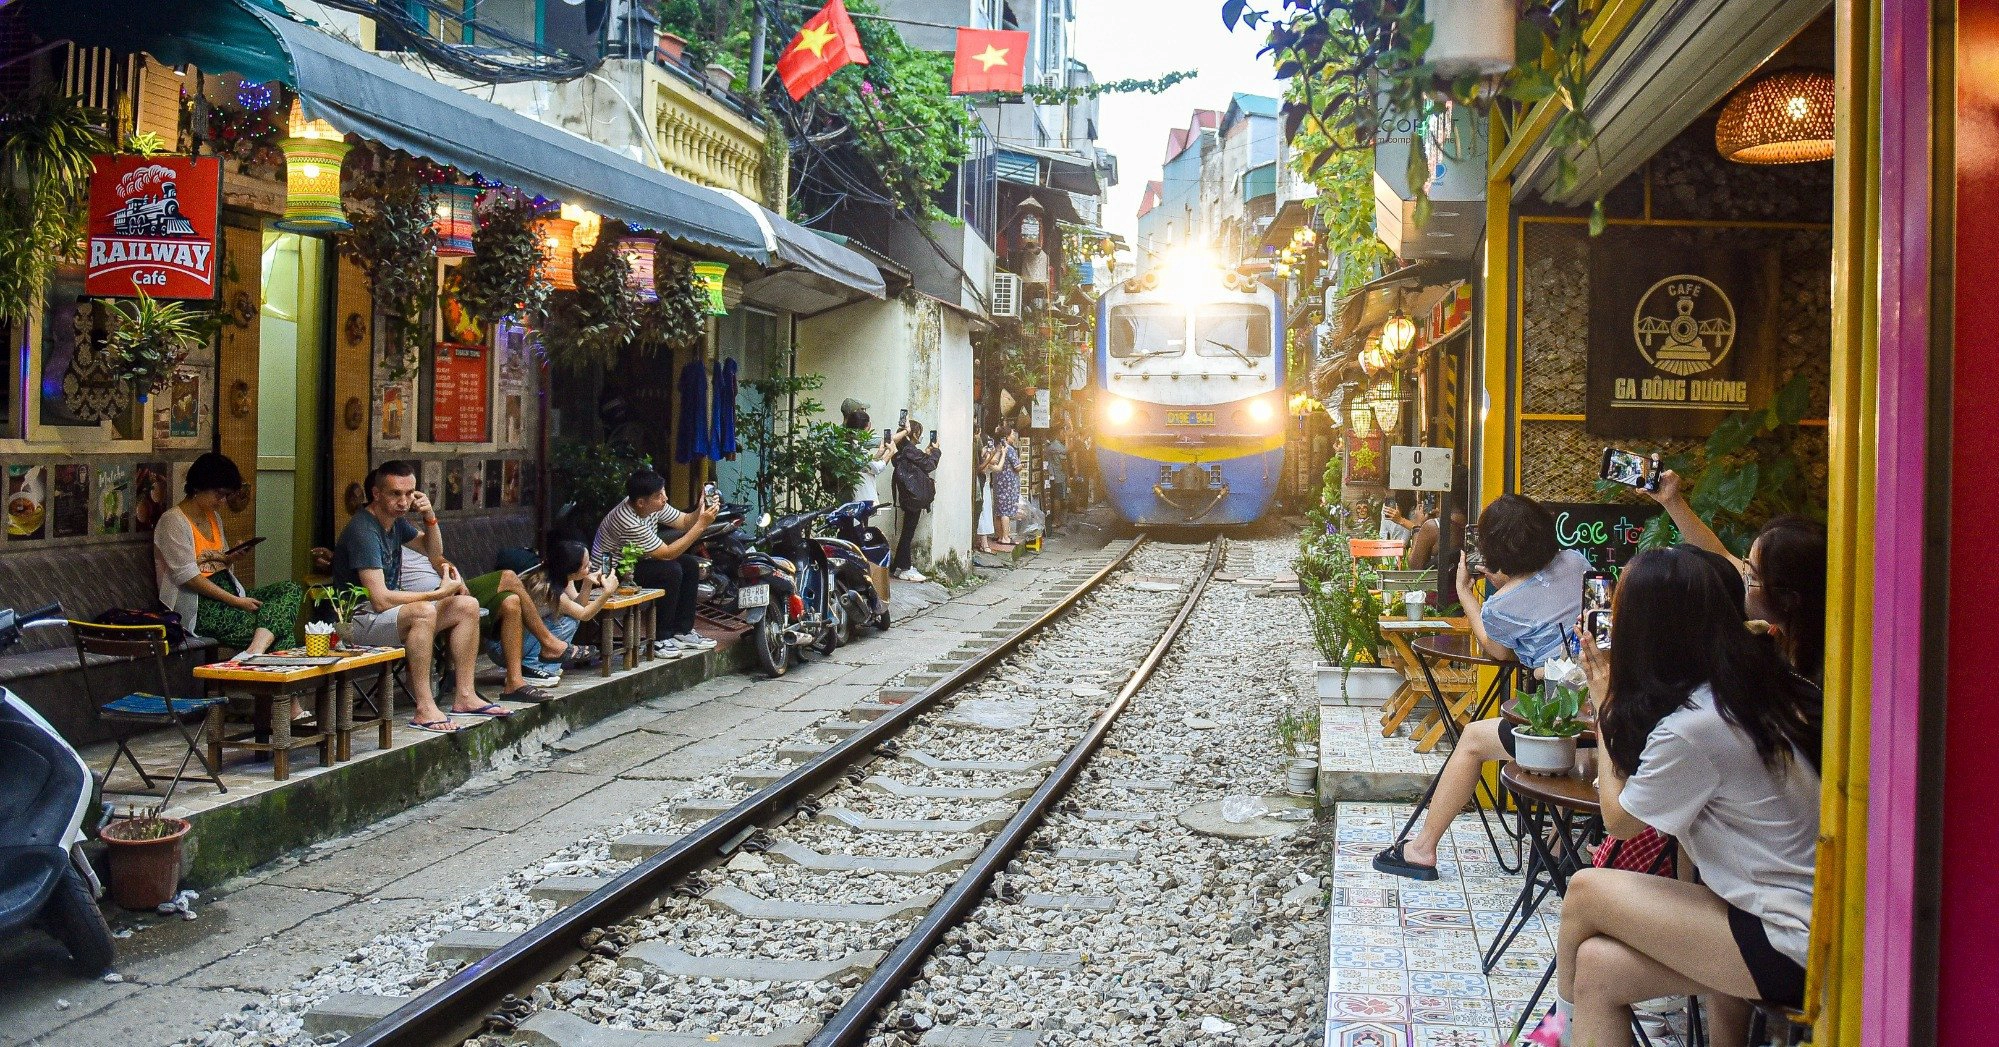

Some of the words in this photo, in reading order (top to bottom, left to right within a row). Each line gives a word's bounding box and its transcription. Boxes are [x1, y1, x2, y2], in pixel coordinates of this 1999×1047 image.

[89, 240, 210, 271] RAILWAY
[132, 270, 167, 285] Café
[1615, 378, 1636, 399] GA
[1641, 375, 1686, 400] ĐÔNG
[1690, 378, 1747, 403] DƯƠNG
[1412, 468, 1422, 487] 8
[1555, 511, 1608, 547] Coc
